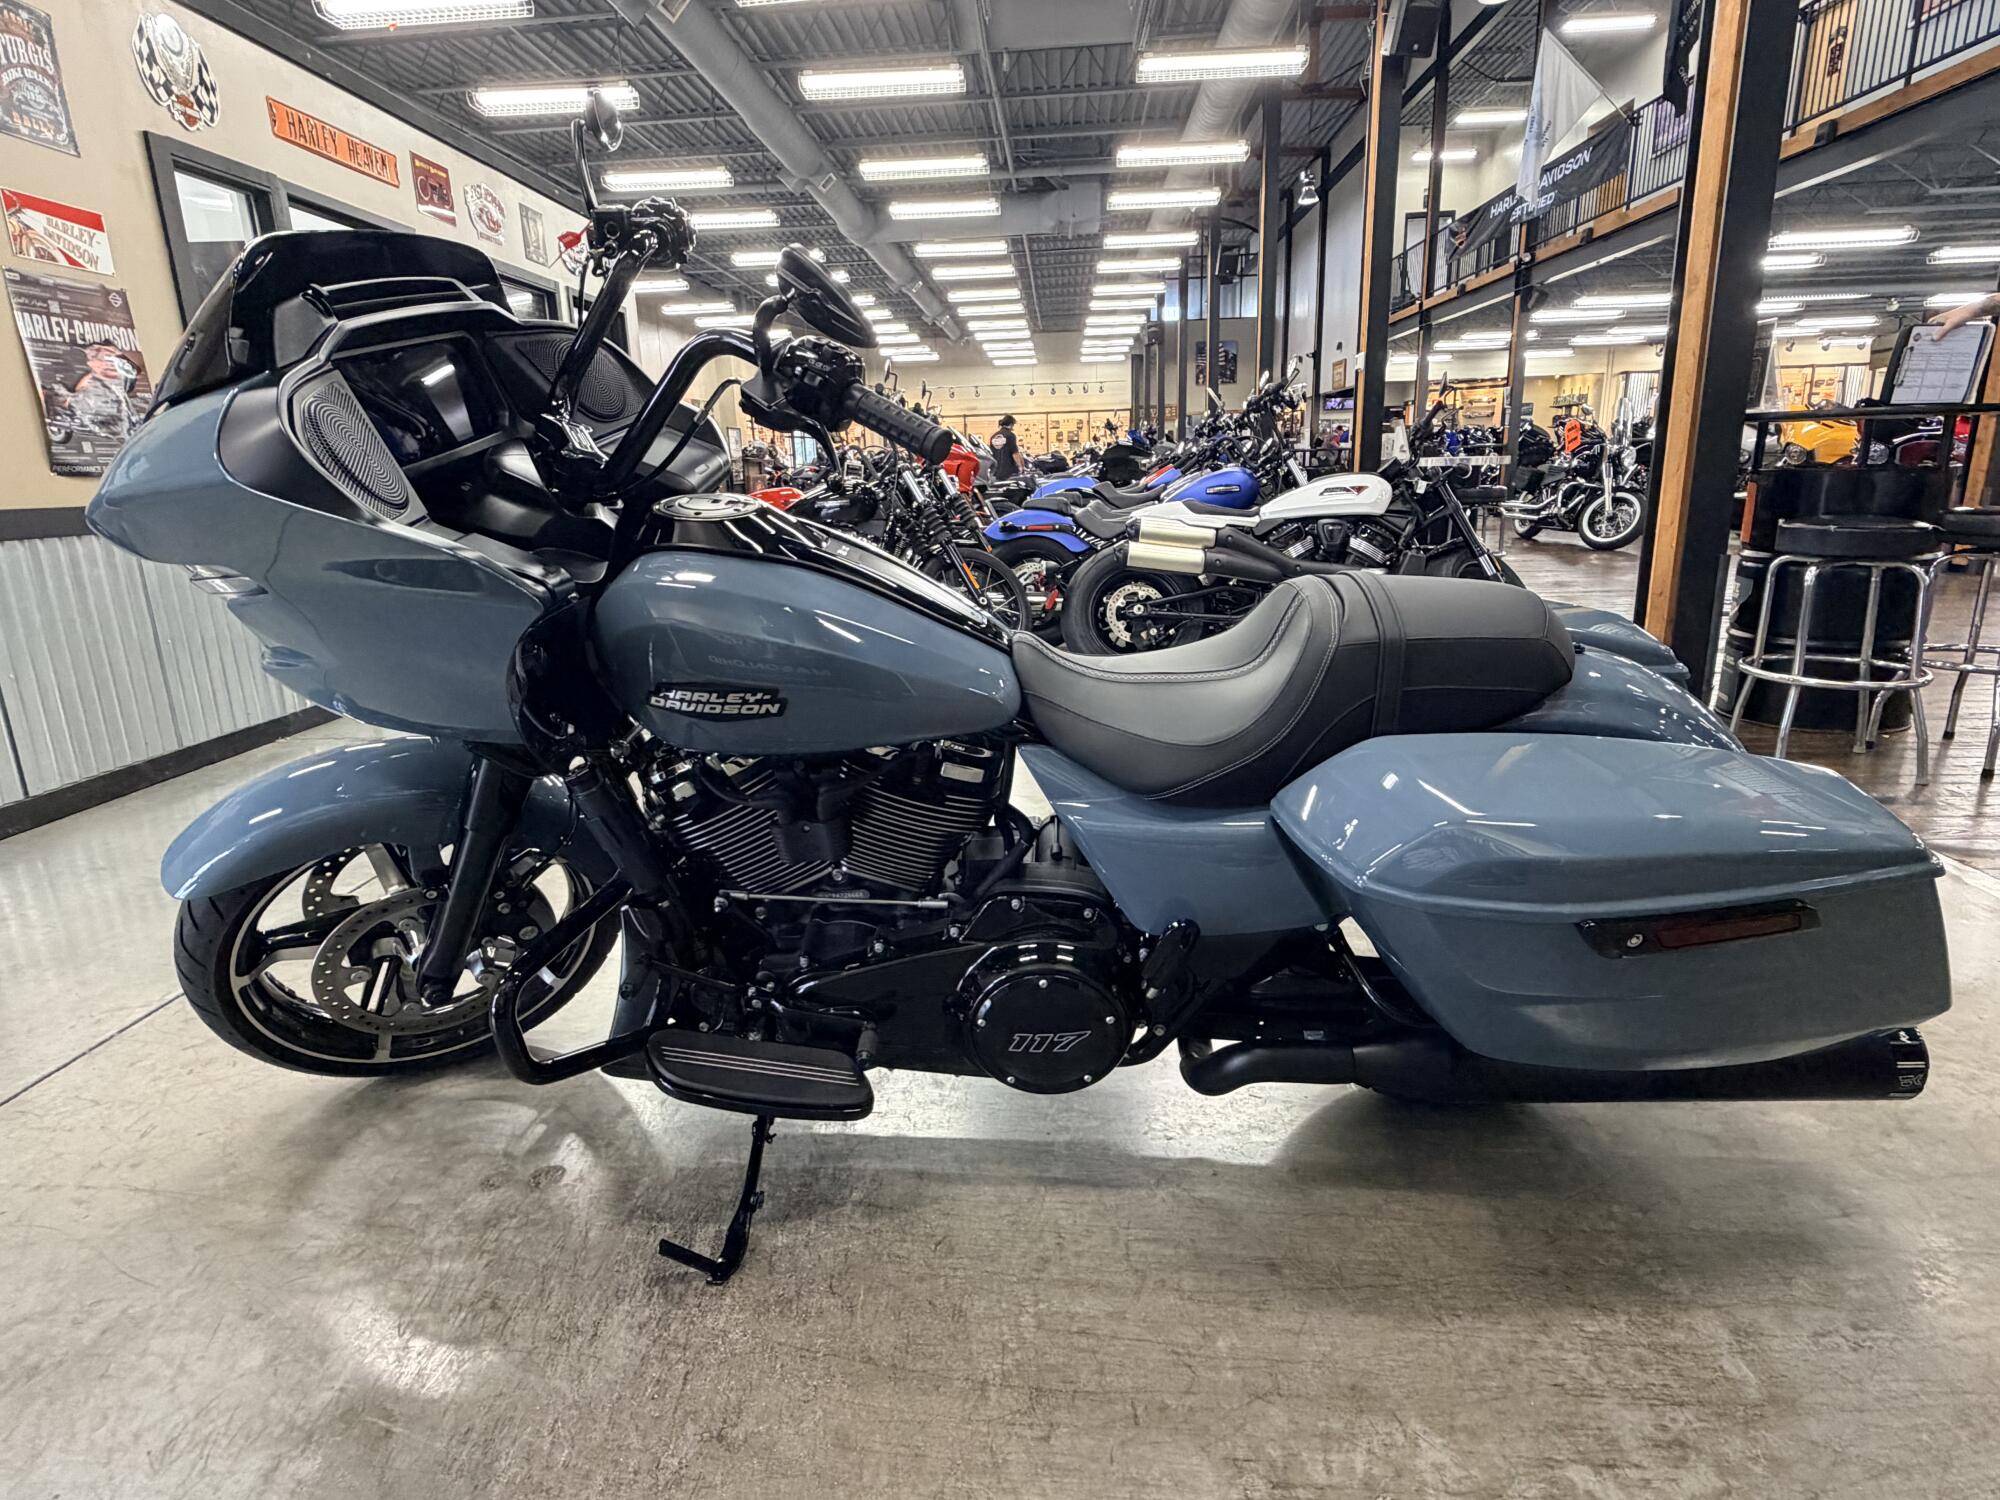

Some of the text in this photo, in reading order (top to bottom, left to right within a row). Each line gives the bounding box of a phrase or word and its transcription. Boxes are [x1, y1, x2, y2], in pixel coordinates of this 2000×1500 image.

[285, 108, 338, 157] HARLEY
[346, 137, 389, 180] HEAVEN
[45, 216, 102, 248] HARLEY-
[42, 225, 99, 270] DAVIDSON
[650, 696, 780, 714] DAVIDSON
[659, 689, 773, 703] HARLEY-
[1008, 1030, 1092, 1053] 117
